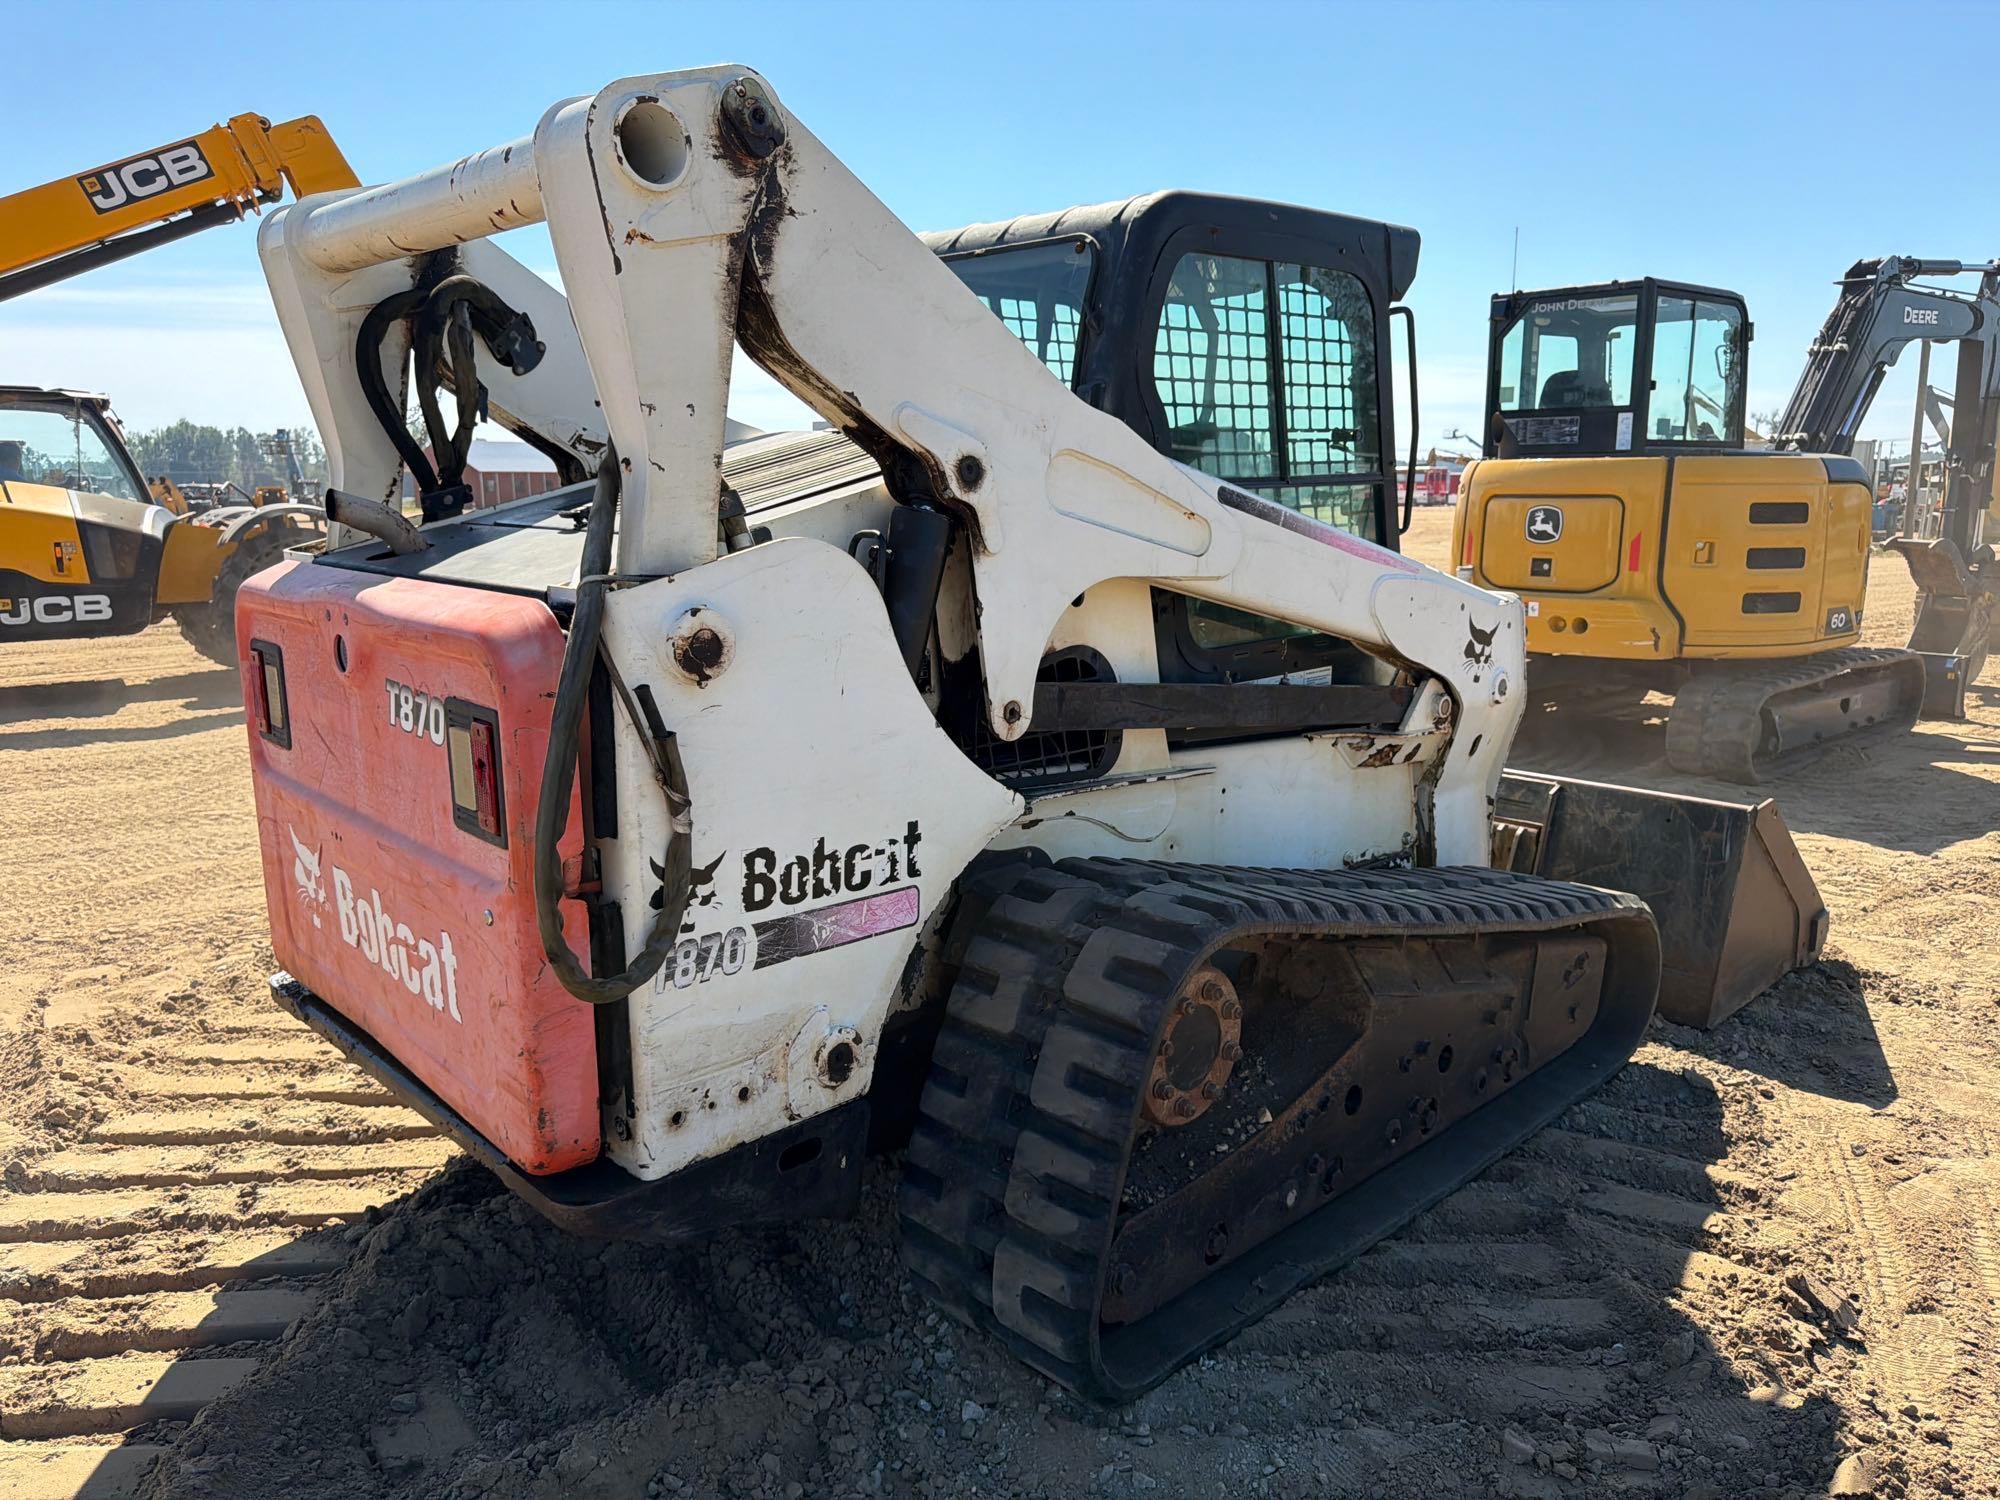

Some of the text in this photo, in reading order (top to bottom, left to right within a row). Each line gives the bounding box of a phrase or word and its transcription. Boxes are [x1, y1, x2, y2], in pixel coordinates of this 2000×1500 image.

[91, 145, 209, 210] JCB
[1531, 300, 1565, 314] JOHN
[1903, 305, 1939, 325] DEERE
[0, 594, 113, 625] JCB
[1830, 612, 1846, 629] 60
[386, 678, 446, 747] T870
[741, 820, 922, 913] Bobcat
[332, 865, 463, 1024] Bobcat
